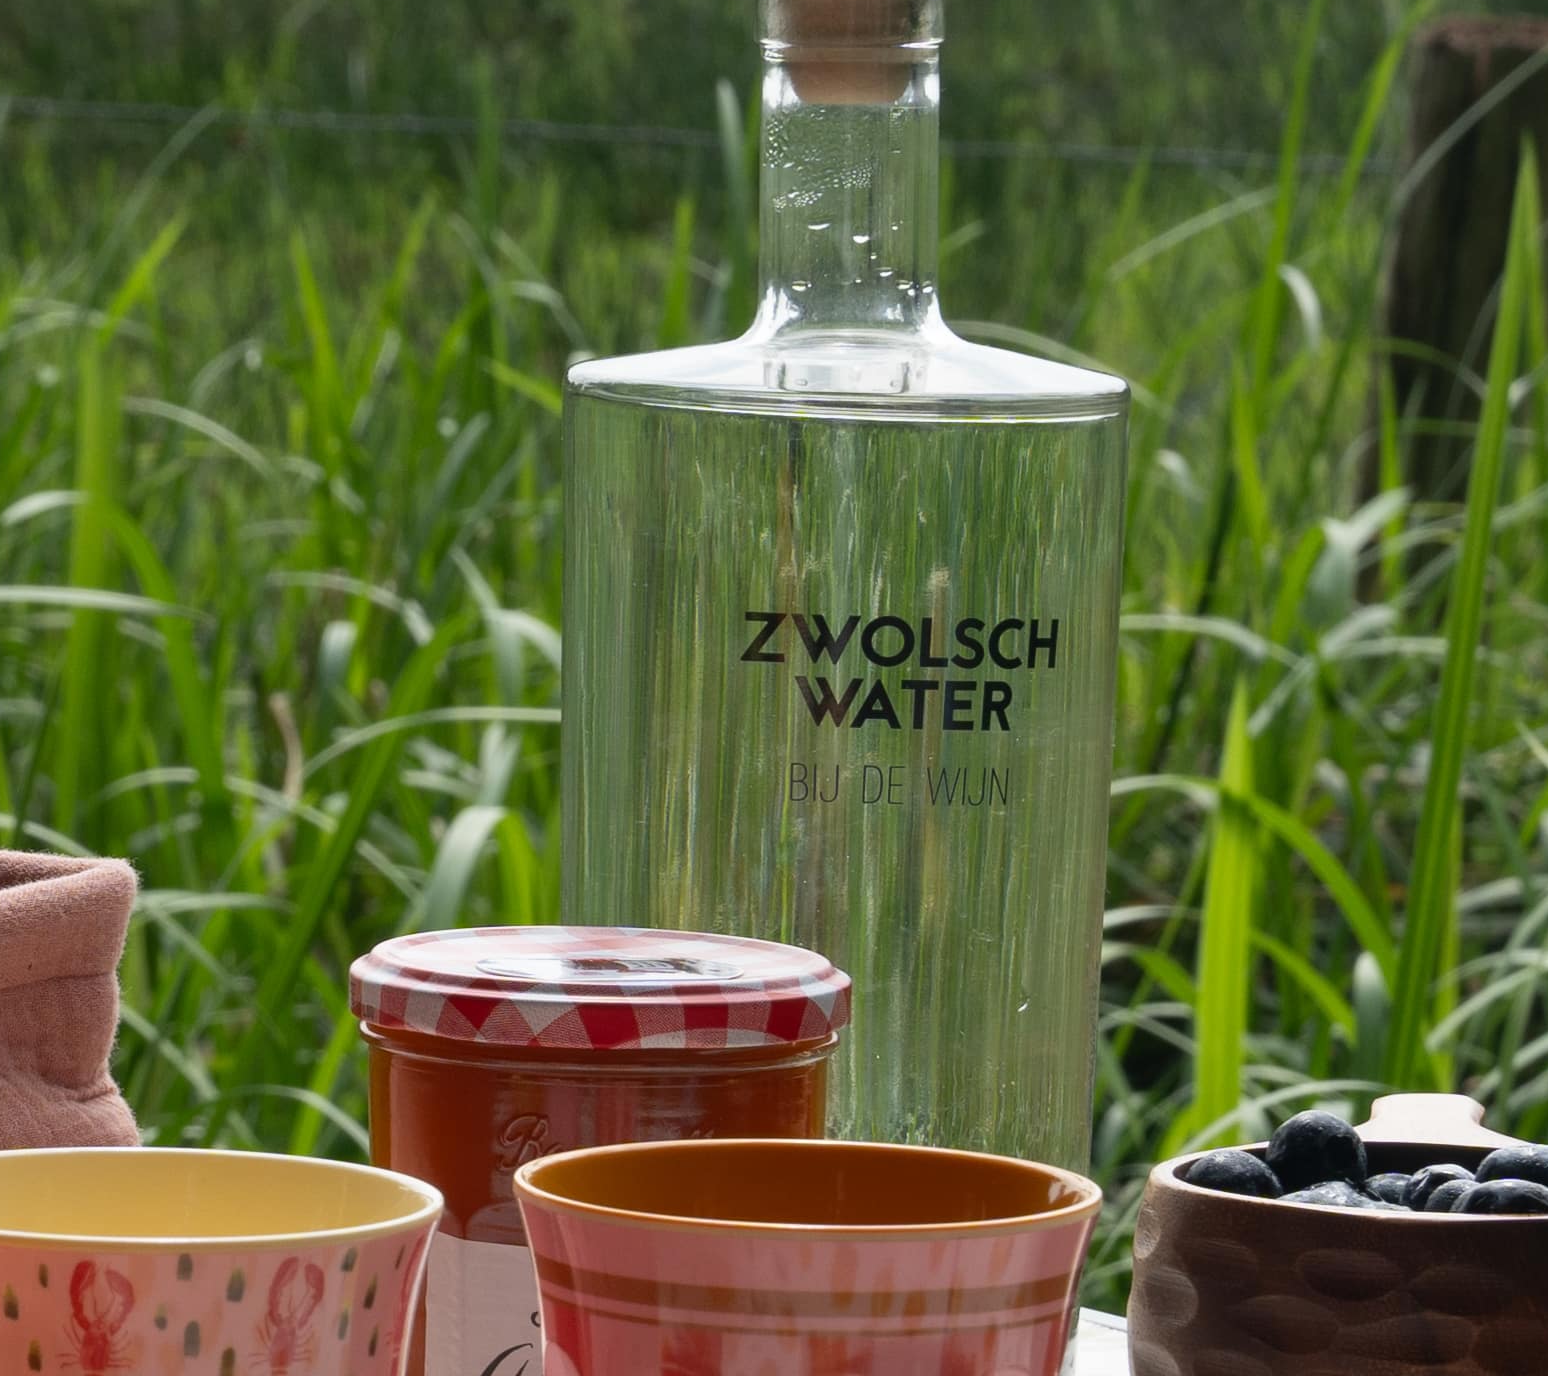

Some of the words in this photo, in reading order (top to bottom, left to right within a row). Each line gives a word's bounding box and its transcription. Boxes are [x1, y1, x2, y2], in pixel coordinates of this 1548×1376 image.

[740, 611, 1059, 669] ZWOLSCH
[794, 675, 1013, 731] WATER
[788, 762, 840, 804] BIJ
[861, 764, 906, 806] DE
[926, 767, 1010, 807] WIJN
